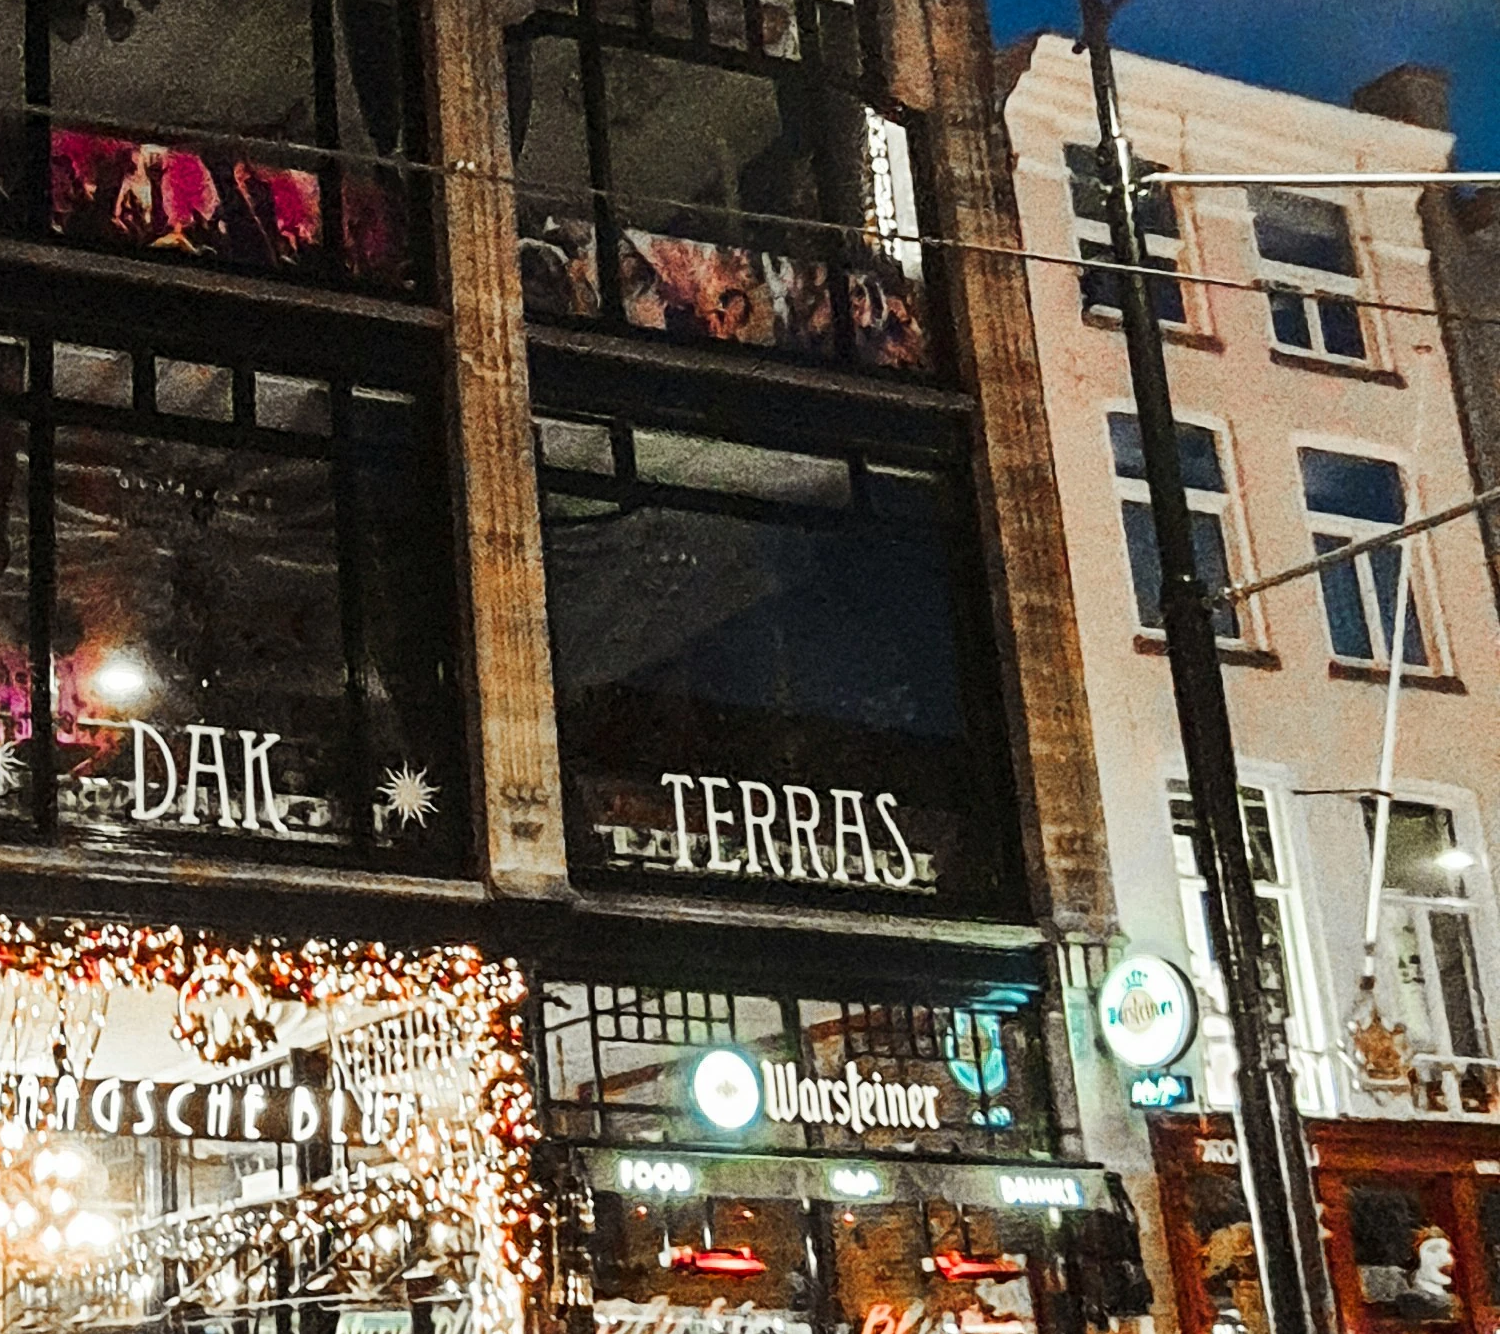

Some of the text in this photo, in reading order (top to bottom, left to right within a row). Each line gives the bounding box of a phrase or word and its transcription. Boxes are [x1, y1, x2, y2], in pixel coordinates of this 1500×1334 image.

[130, 720, 288, 833] DAK
[661, 773, 916, 887] TERRAS
[762, 1060, 940, 1134] Warsteiner
